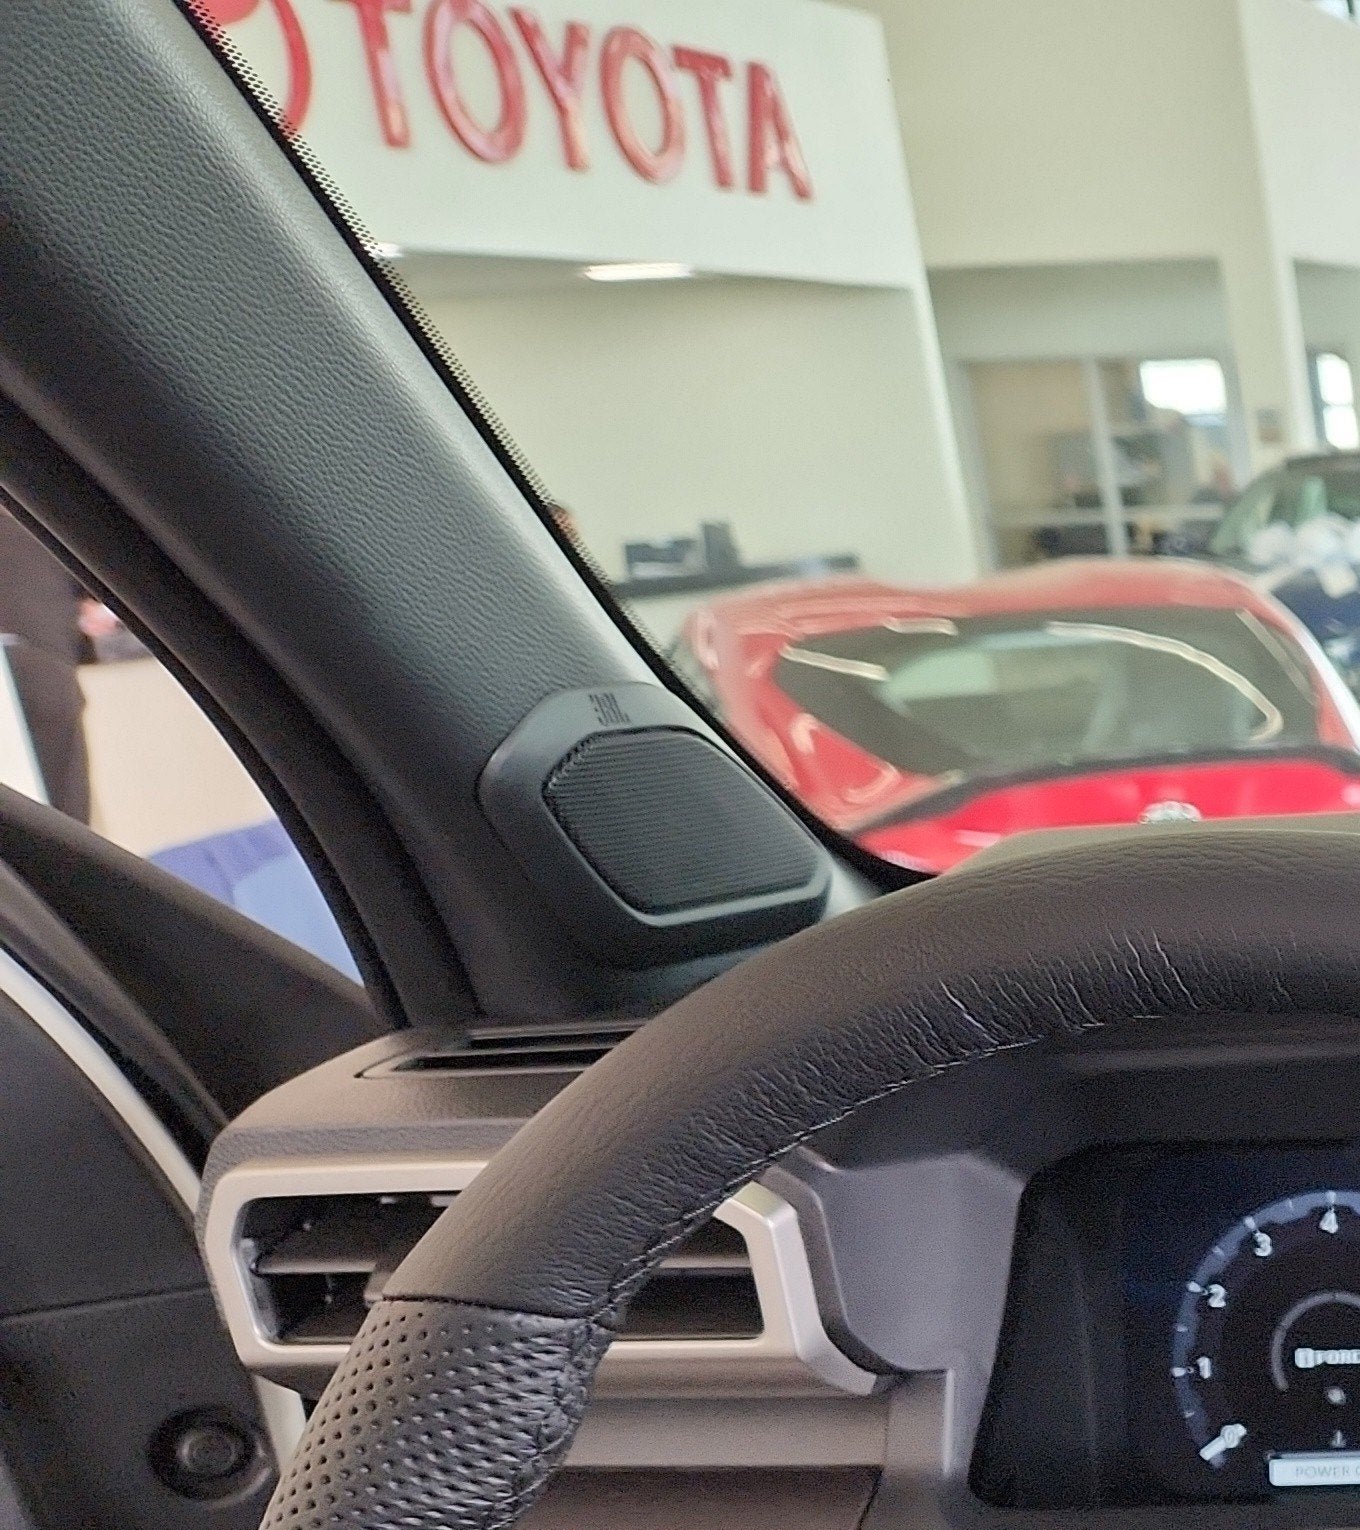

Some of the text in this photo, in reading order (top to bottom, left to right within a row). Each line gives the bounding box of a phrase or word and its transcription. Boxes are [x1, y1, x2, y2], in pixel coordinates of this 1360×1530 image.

[345, 0, 815, 201] TOYOTA
[1253, 1232, 1273, 1258] 3
[1208, 1283, 1227, 1308] 2
[1294, 1464, 1350, 1479] POWER
